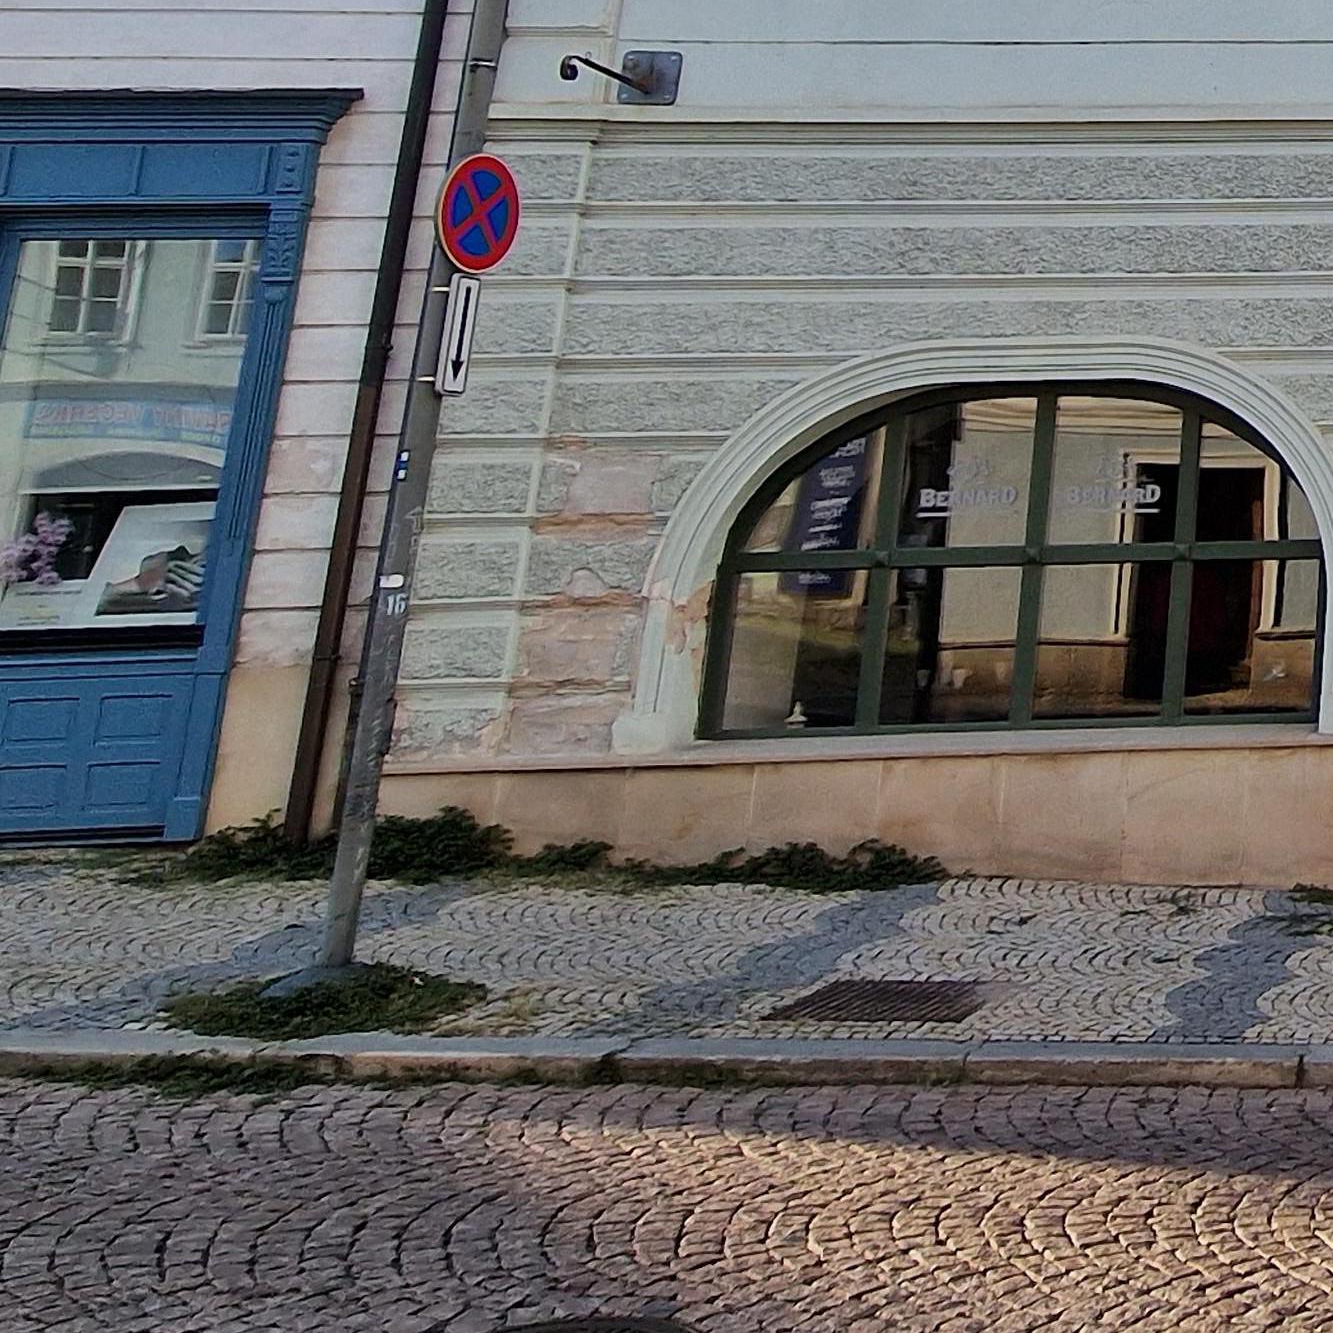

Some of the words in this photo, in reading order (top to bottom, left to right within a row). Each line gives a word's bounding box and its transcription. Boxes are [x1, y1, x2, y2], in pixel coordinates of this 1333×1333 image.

[919, 486, 1019, 509] BERNARD
[1067, 484, 1161, 505] BERNARD
[386, 593, 409, 616] 16
